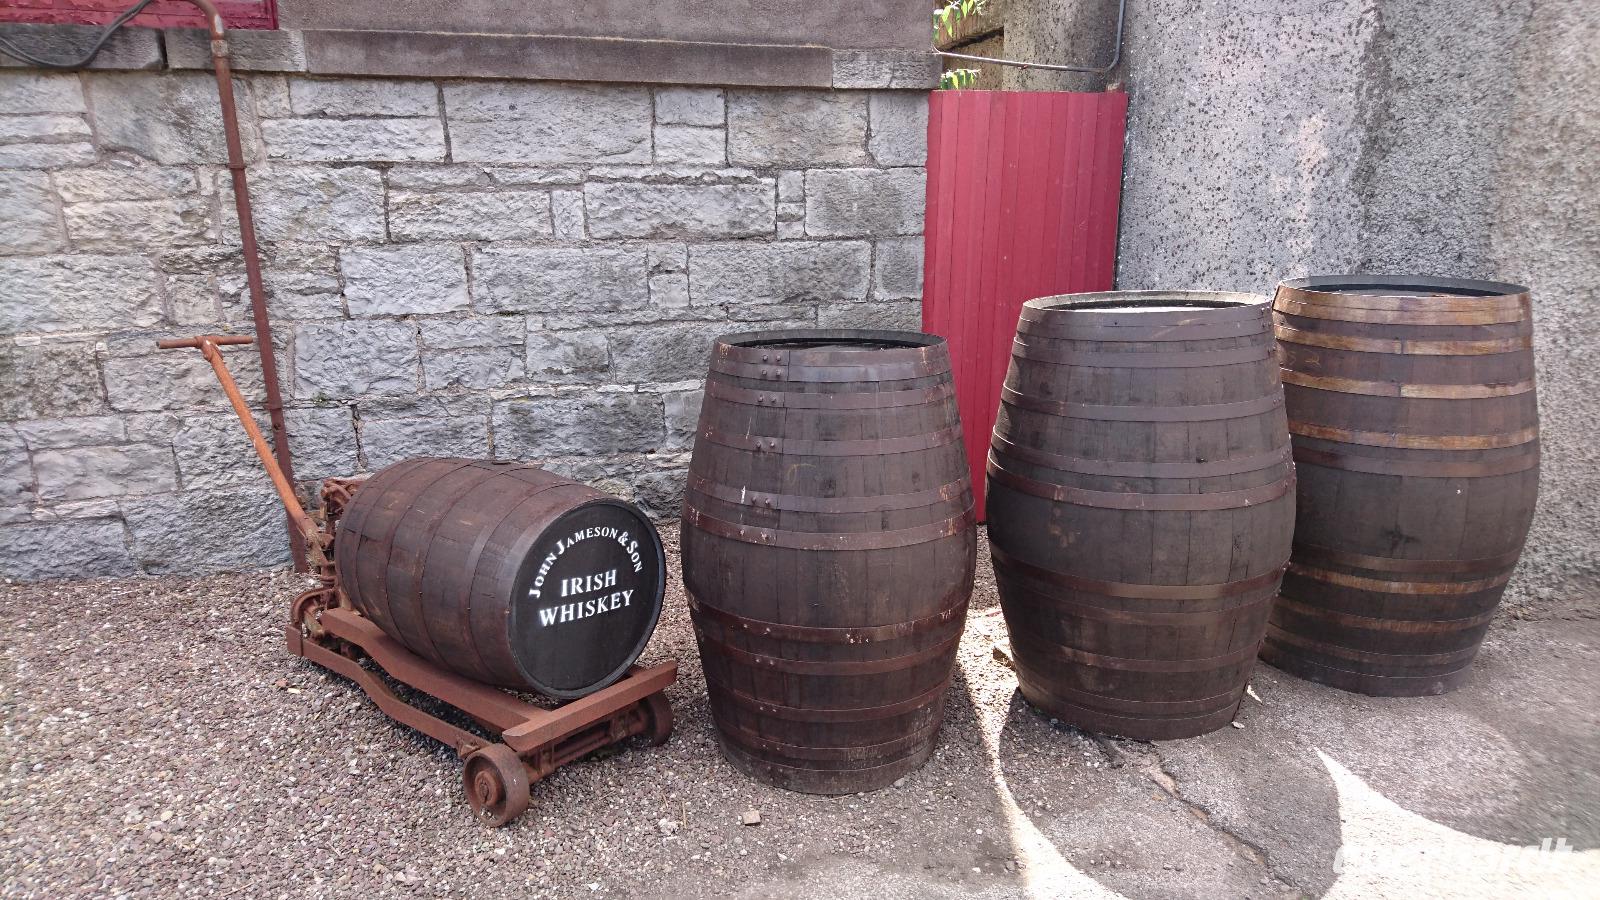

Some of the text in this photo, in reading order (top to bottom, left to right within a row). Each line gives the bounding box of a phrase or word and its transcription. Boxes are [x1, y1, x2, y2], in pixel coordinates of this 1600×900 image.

[528, 526, 643, 599] JOHN JAMESON & SON
[560, 569, 617, 597] IRISH
[538, 589, 634, 627] WHISKEY
